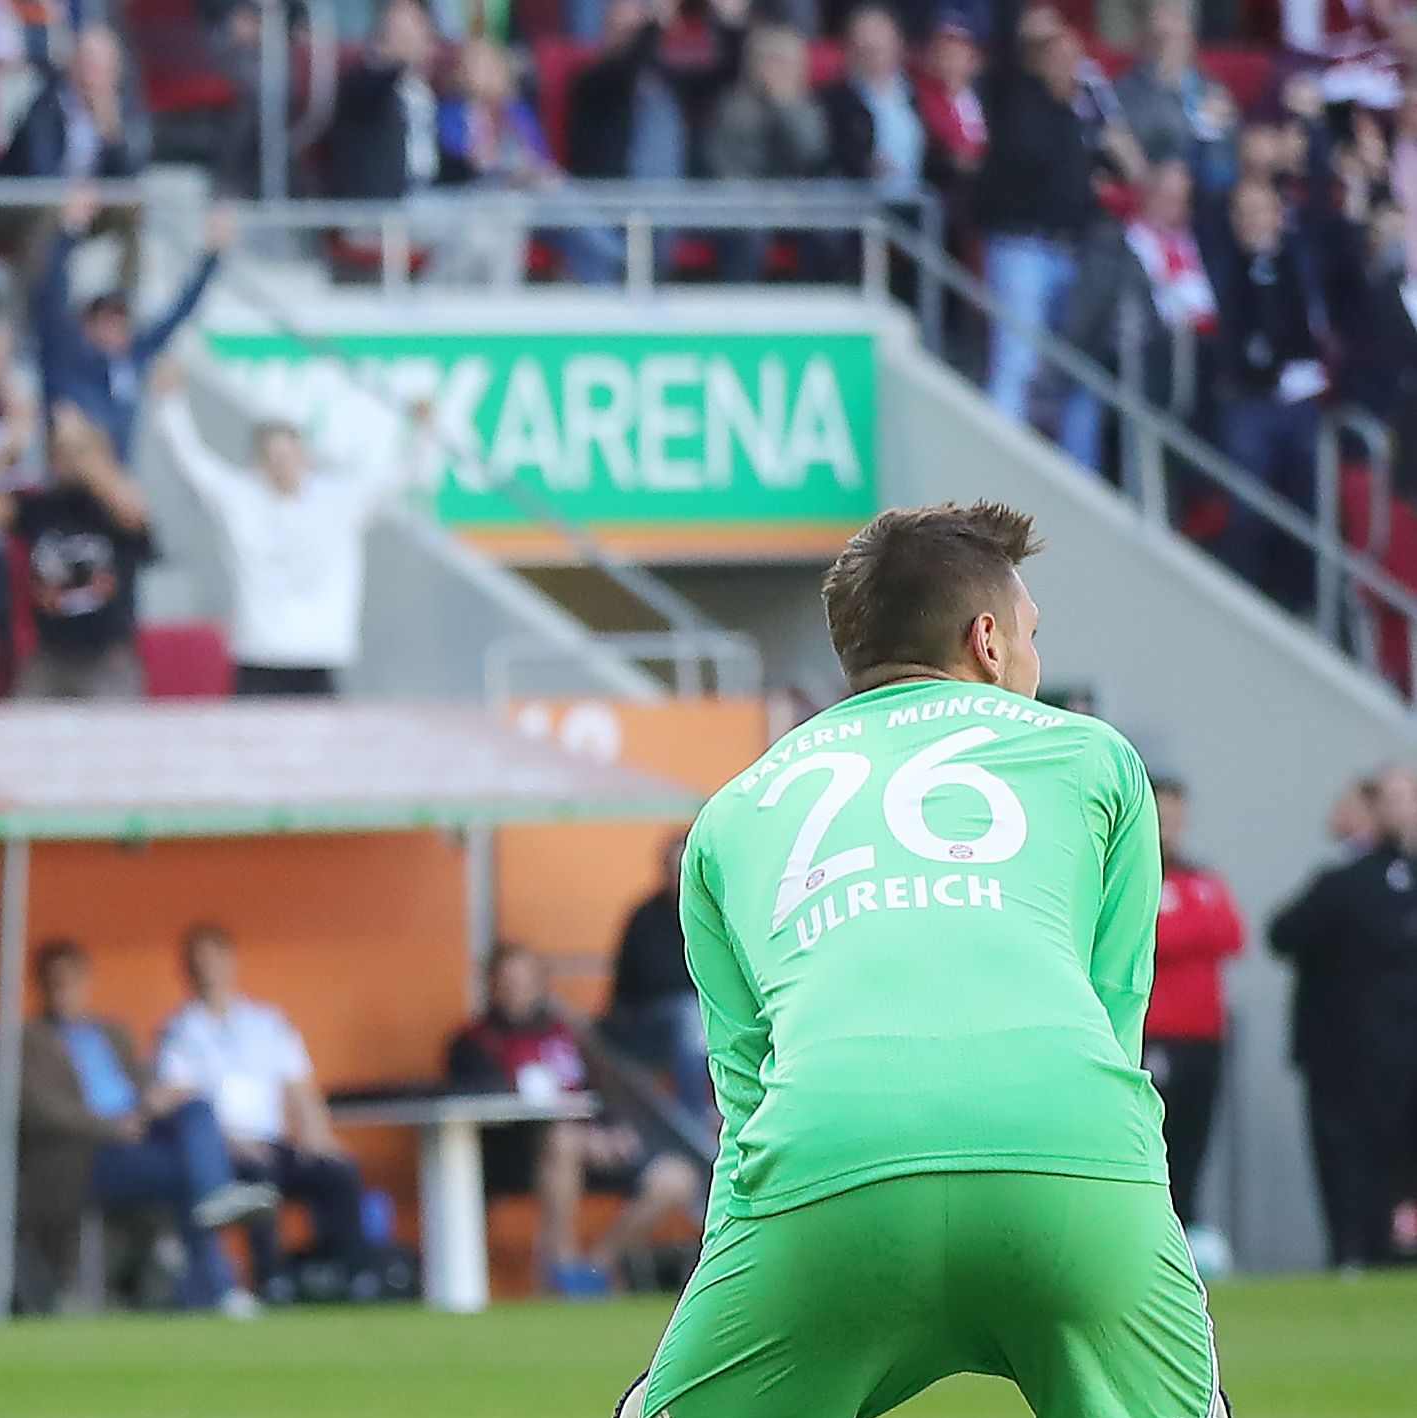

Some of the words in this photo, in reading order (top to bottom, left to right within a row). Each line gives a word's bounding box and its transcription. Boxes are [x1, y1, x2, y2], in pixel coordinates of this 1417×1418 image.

[740, 720, 863, 791] BAYERN
[756, 726, 1026, 930] 26
[795, 874, 1003, 948] ULREICH
